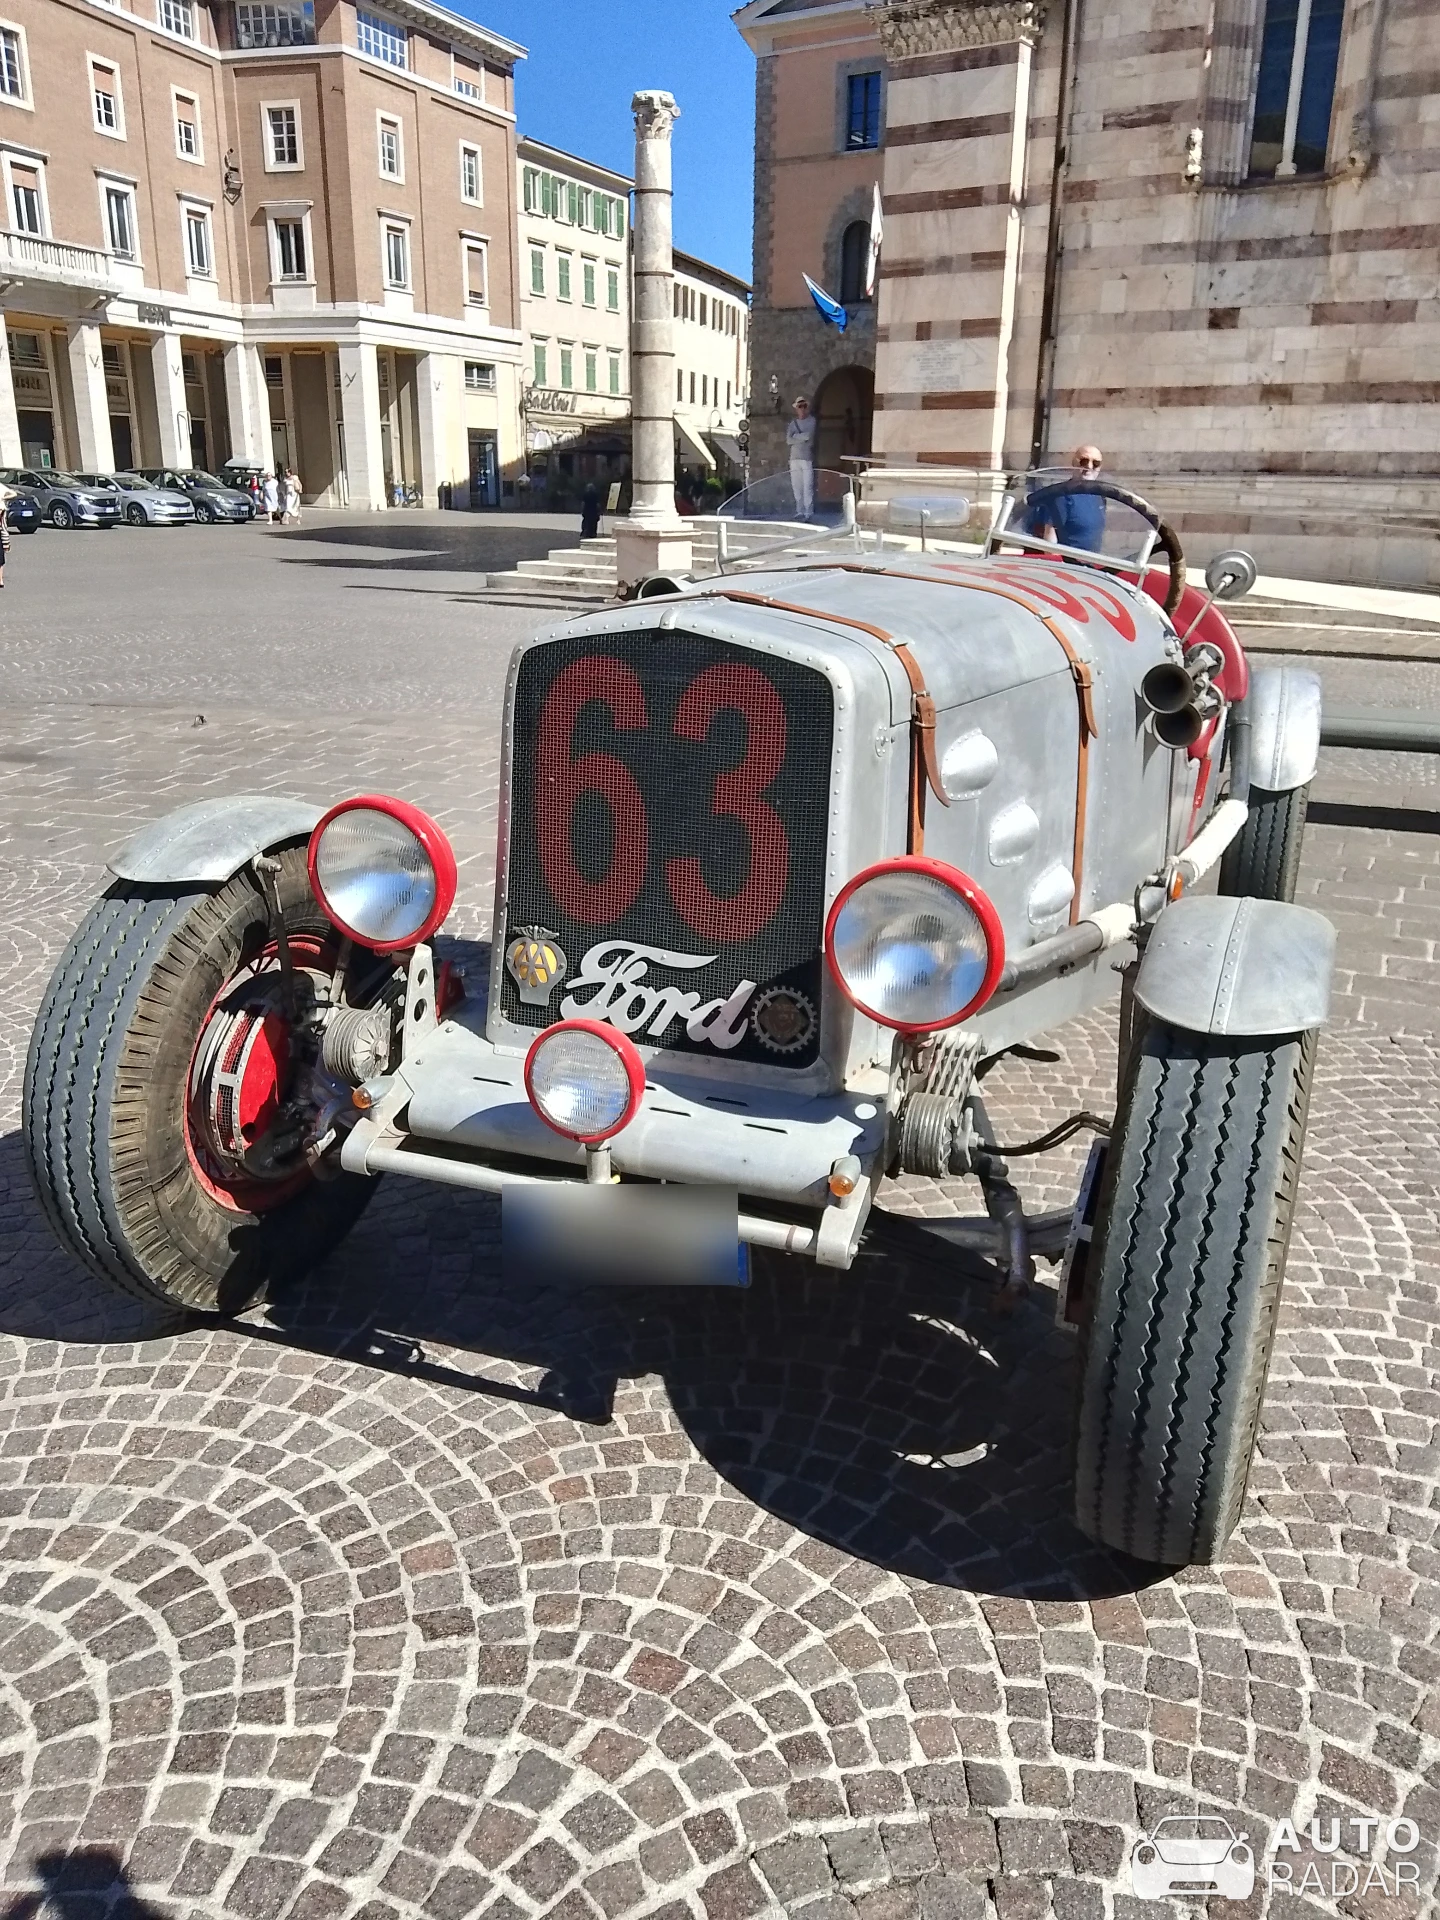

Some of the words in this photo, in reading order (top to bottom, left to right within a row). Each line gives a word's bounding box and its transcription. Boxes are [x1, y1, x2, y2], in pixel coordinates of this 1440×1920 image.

[536, 655, 790, 943] 63
[515, 940, 554, 988] AA
[559, 939, 758, 1050] Ford
